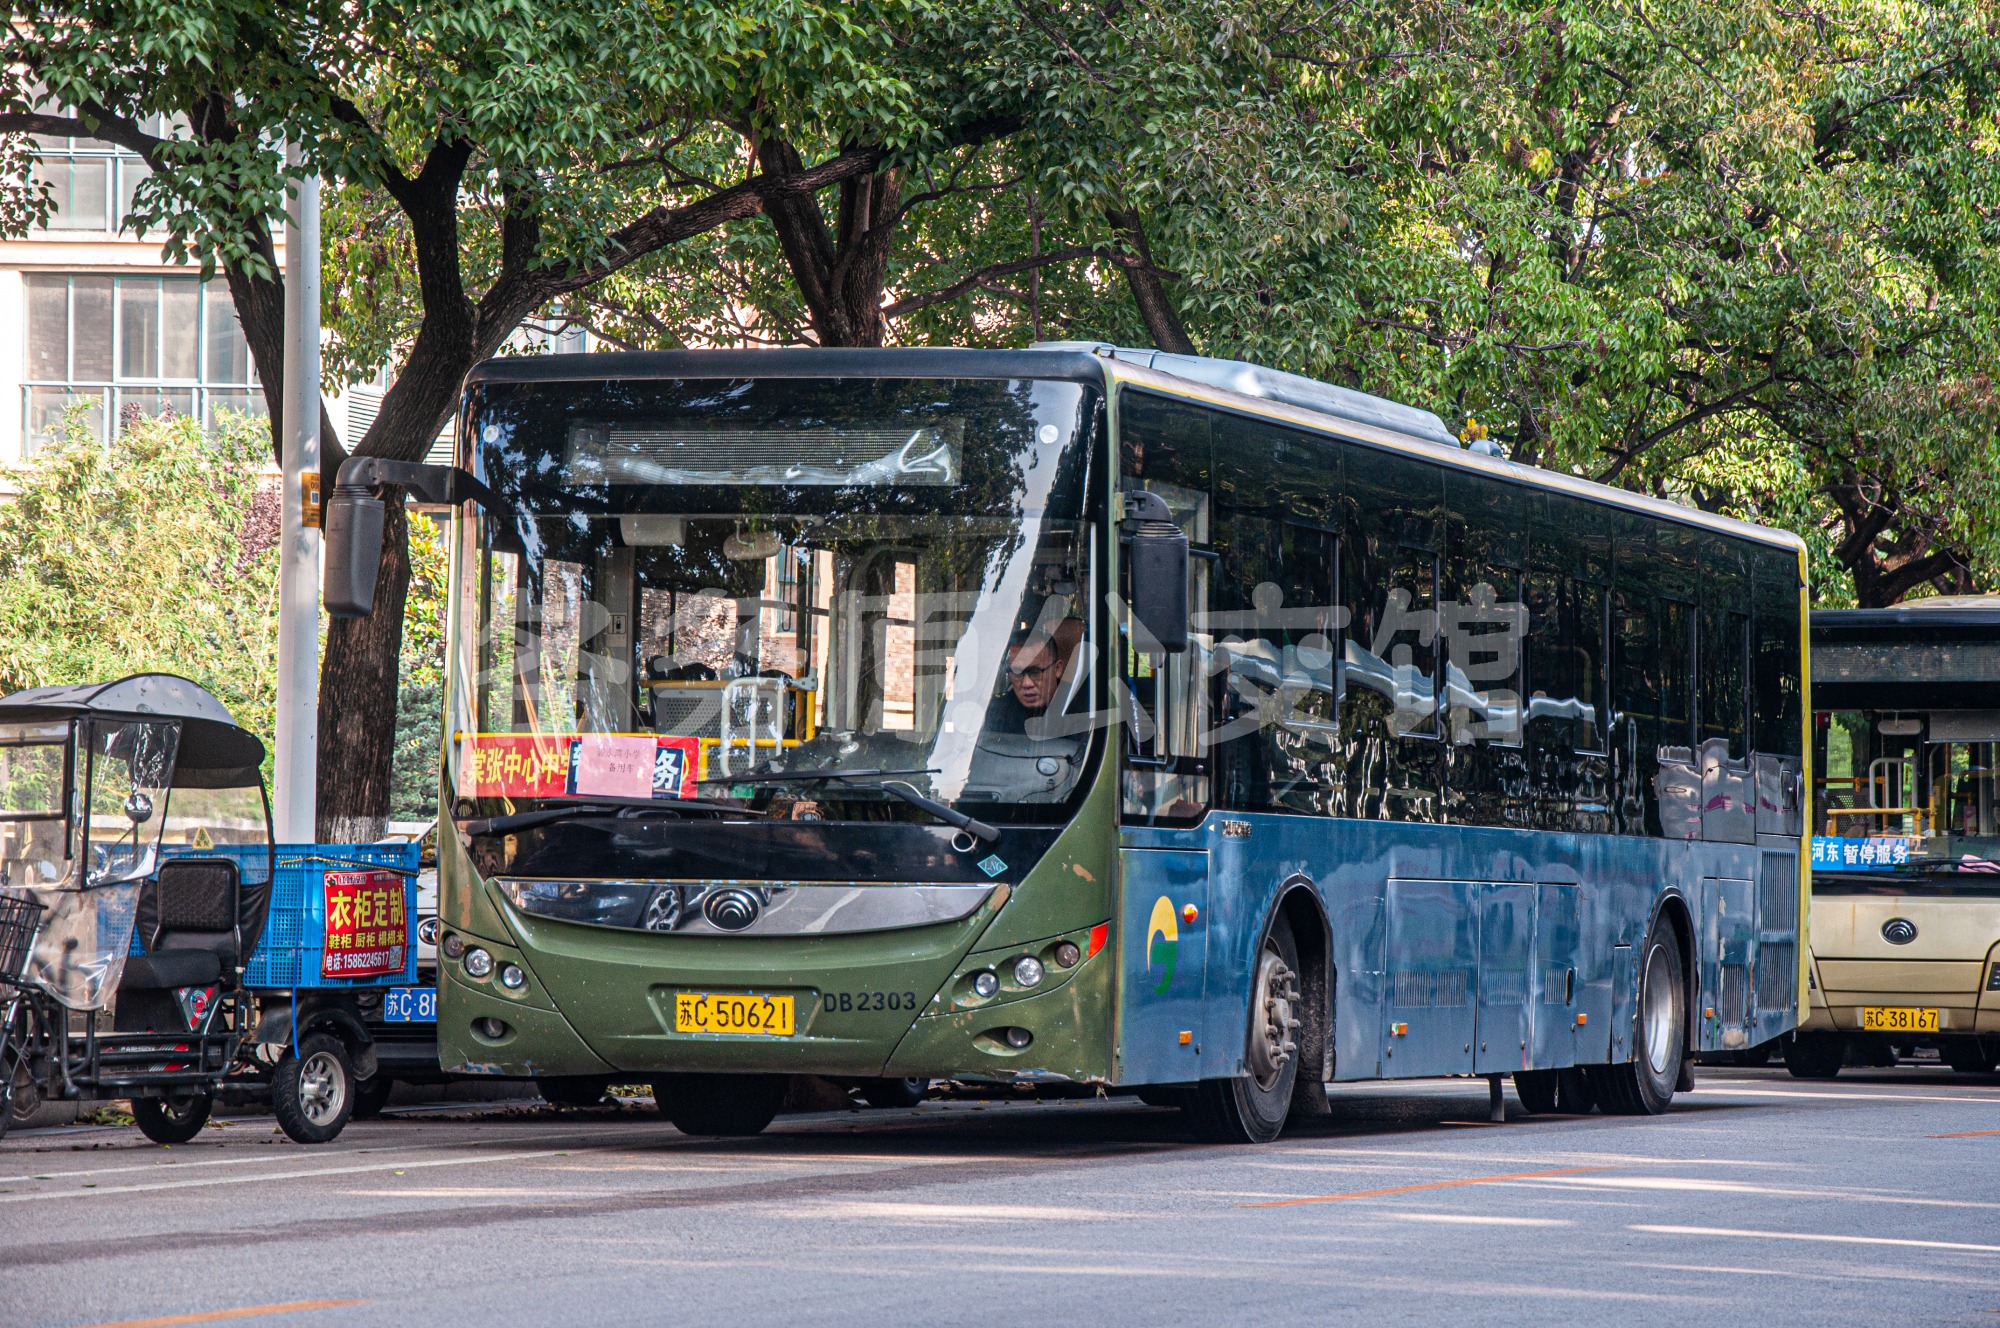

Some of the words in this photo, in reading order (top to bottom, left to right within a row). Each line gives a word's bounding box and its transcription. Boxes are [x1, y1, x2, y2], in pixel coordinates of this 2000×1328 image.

[1812, 839, 1839, 862] 河东
[1843, 844, 1908, 864] 暂停服务
[329, 887, 404, 930] 衣柜定制
[328, 933, 352, 949] 鞋柜
[355, 932, 375, 948] 厨柜
[378, 929, 405, 946] 榻榻米
[823, 991, 917, 1013] DB2303
[680, 1000, 786, 1029] 苏C·50621
[1865, 1011, 1938, 1028] 苏C·38167
